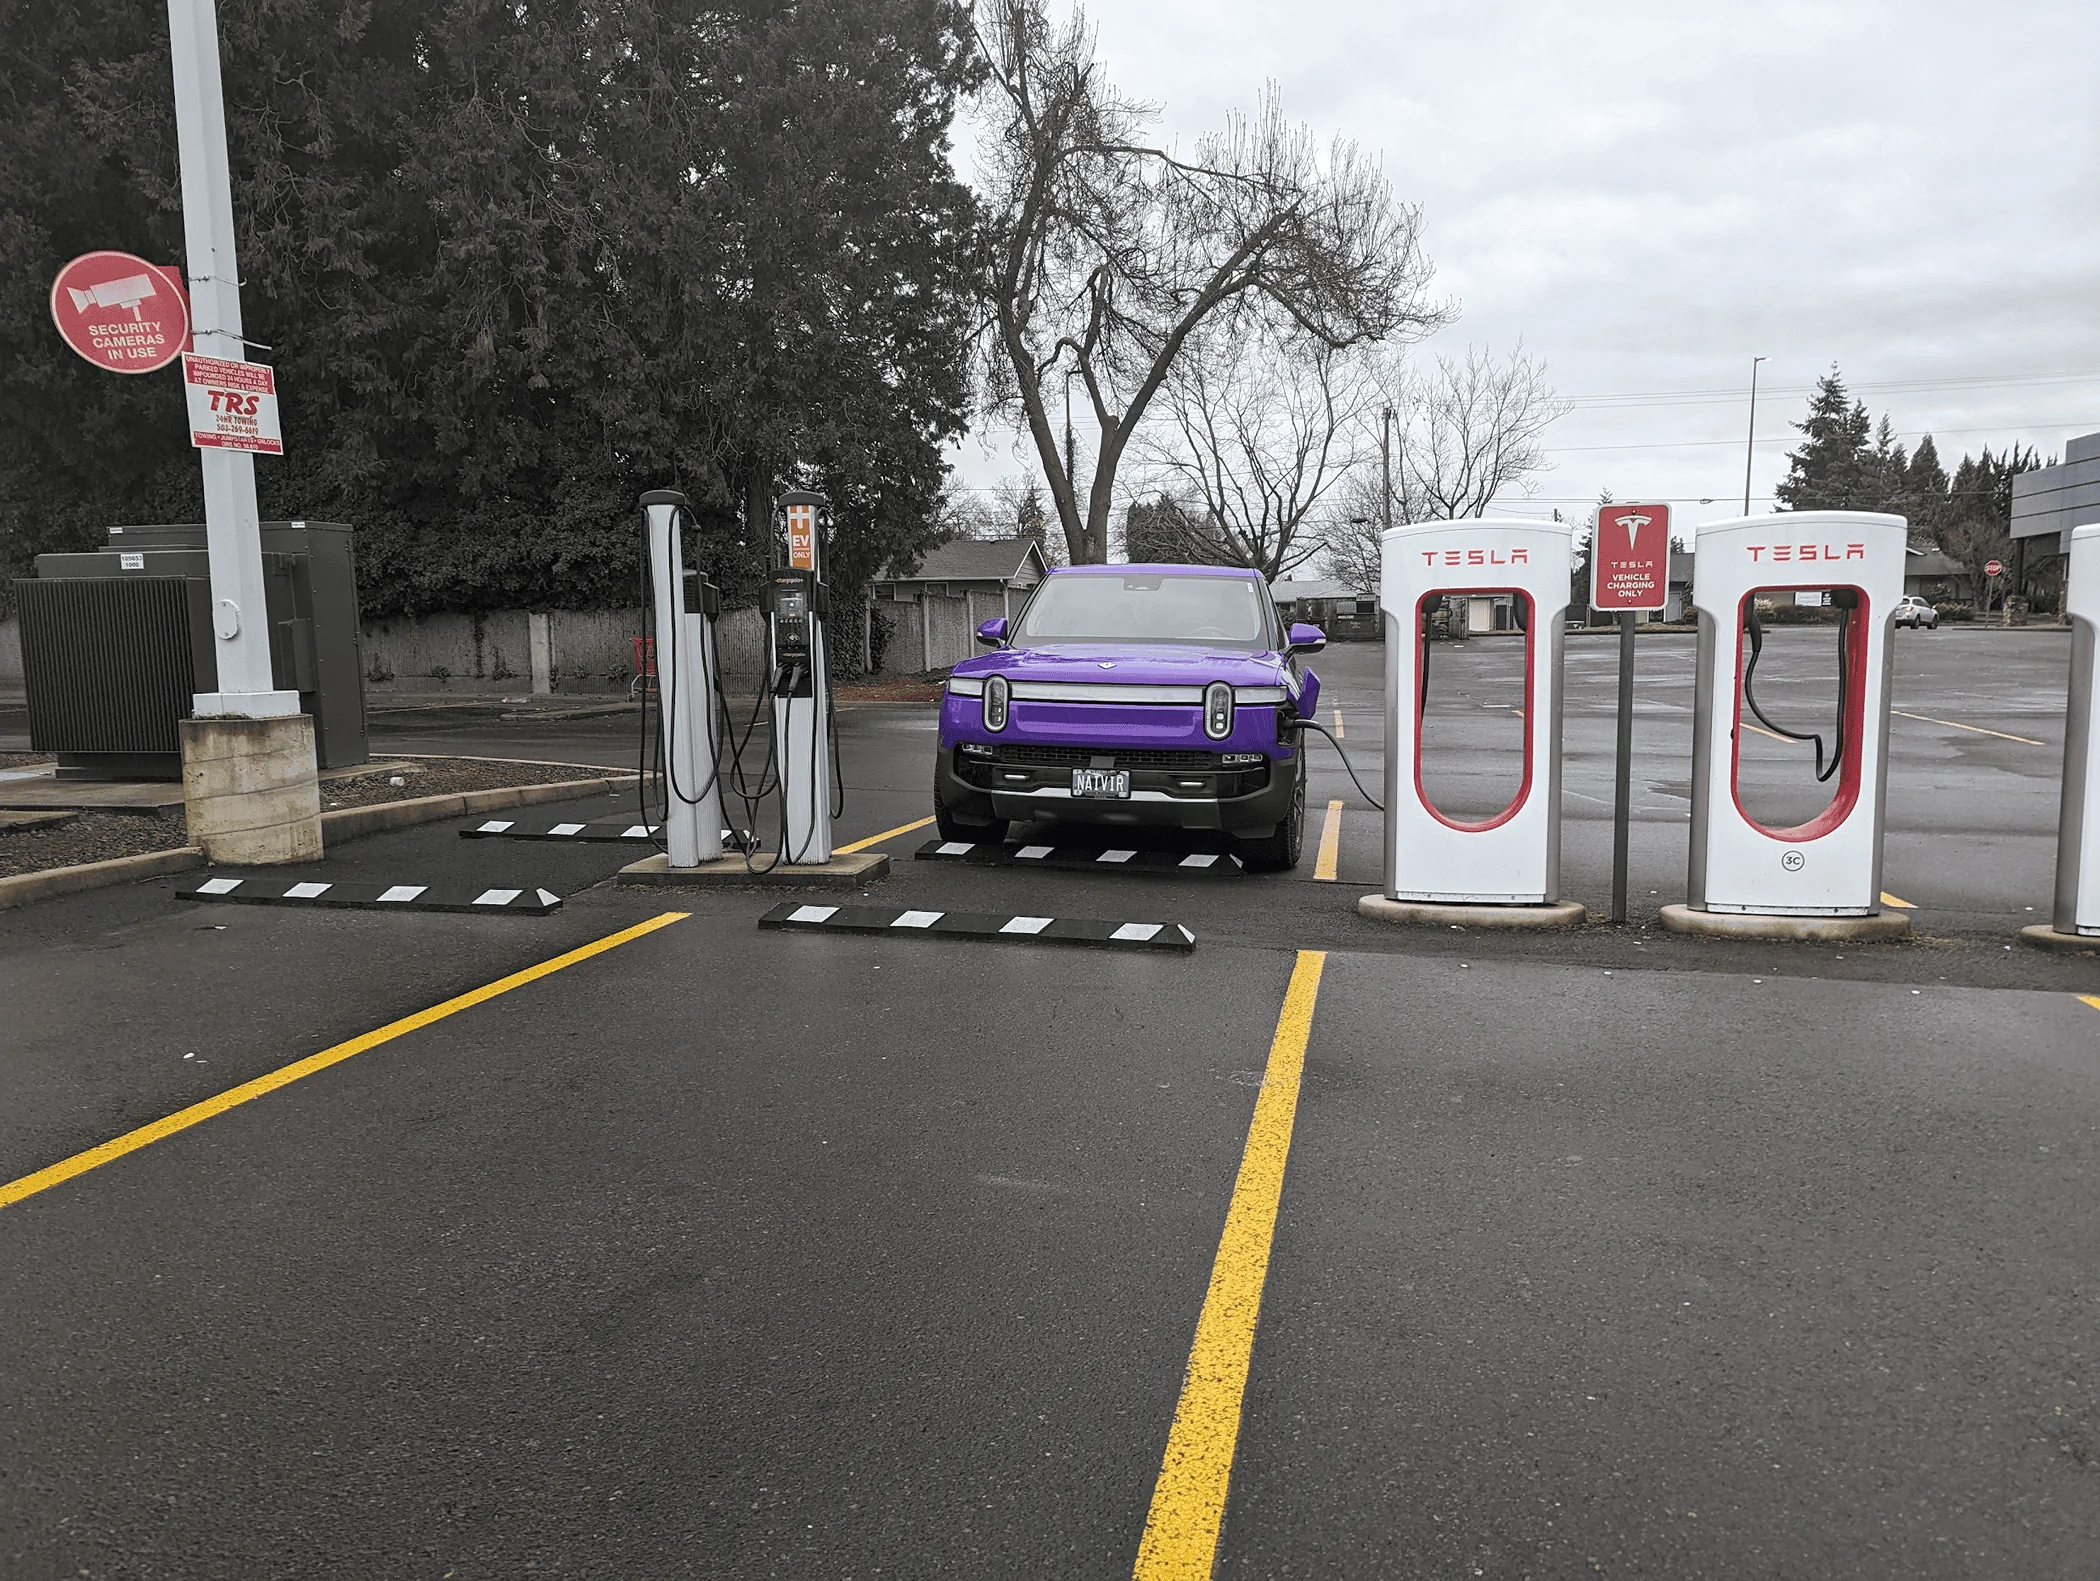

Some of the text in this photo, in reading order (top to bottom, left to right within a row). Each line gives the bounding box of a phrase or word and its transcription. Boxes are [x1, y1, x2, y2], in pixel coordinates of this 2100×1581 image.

[88, 321, 161, 336] SECURITY
[92, 334, 165, 348] CAMERAS
[107, 347, 157, 360] IN USE
[186, 355, 230, 368] UNAUTHORIZED
[239, 364, 270, 374] IMPROPERLY
[194, 363, 218, 373] PARKED
[219, 367, 245, 377] VEHICLES
[193, 370, 226, 380] IMPOUNDED
[246, 385, 269, 393] EXPENSE
[207, 390, 260, 415] TRS
[234, 417, 258, 426] TOWING
[216, 423, 259, 435] 503-269-6619
[792, 534, 809, 547] EV
[1421, 549, 1528, 566] TESLA
[1746, 544, 1864, 562] TESLA
[1612, 573, 1650, 581] VEHICLE
[1607, 581, 1655, 590] CHARGING
[1077, 775, 1124, 792] NAIVIR
[1785, 856, 1801, 865] 3C
